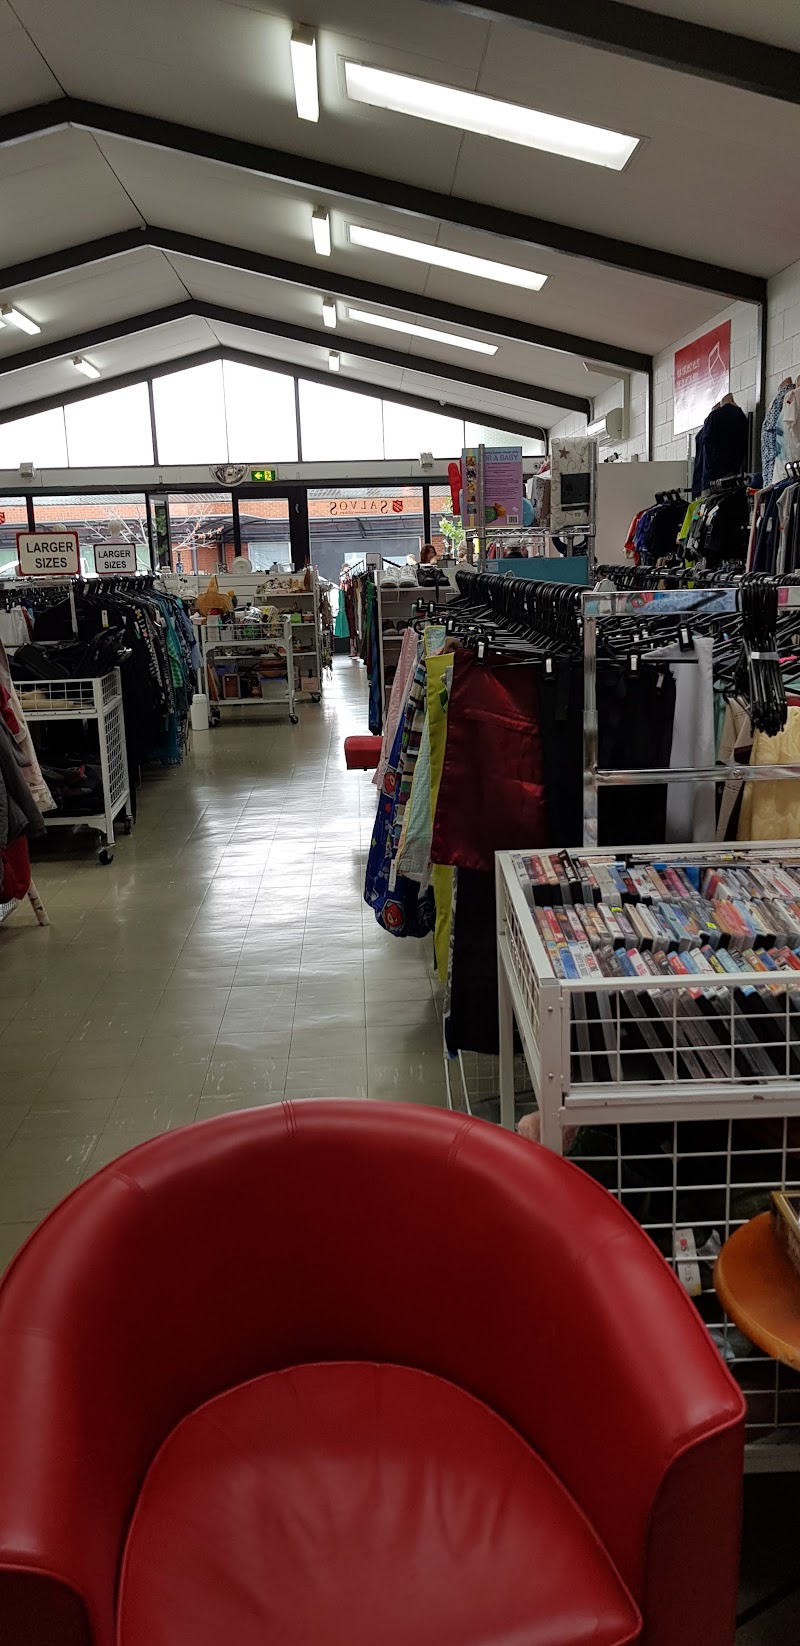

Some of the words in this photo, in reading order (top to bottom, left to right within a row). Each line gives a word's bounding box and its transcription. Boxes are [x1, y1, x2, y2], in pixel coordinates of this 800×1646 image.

[26, 541, 74, 553] LARGER
[98, 549, 131, 559] LARGER
[35, 557, 68, 569] SIZES
[104, 560, 127, 569] SIZES
